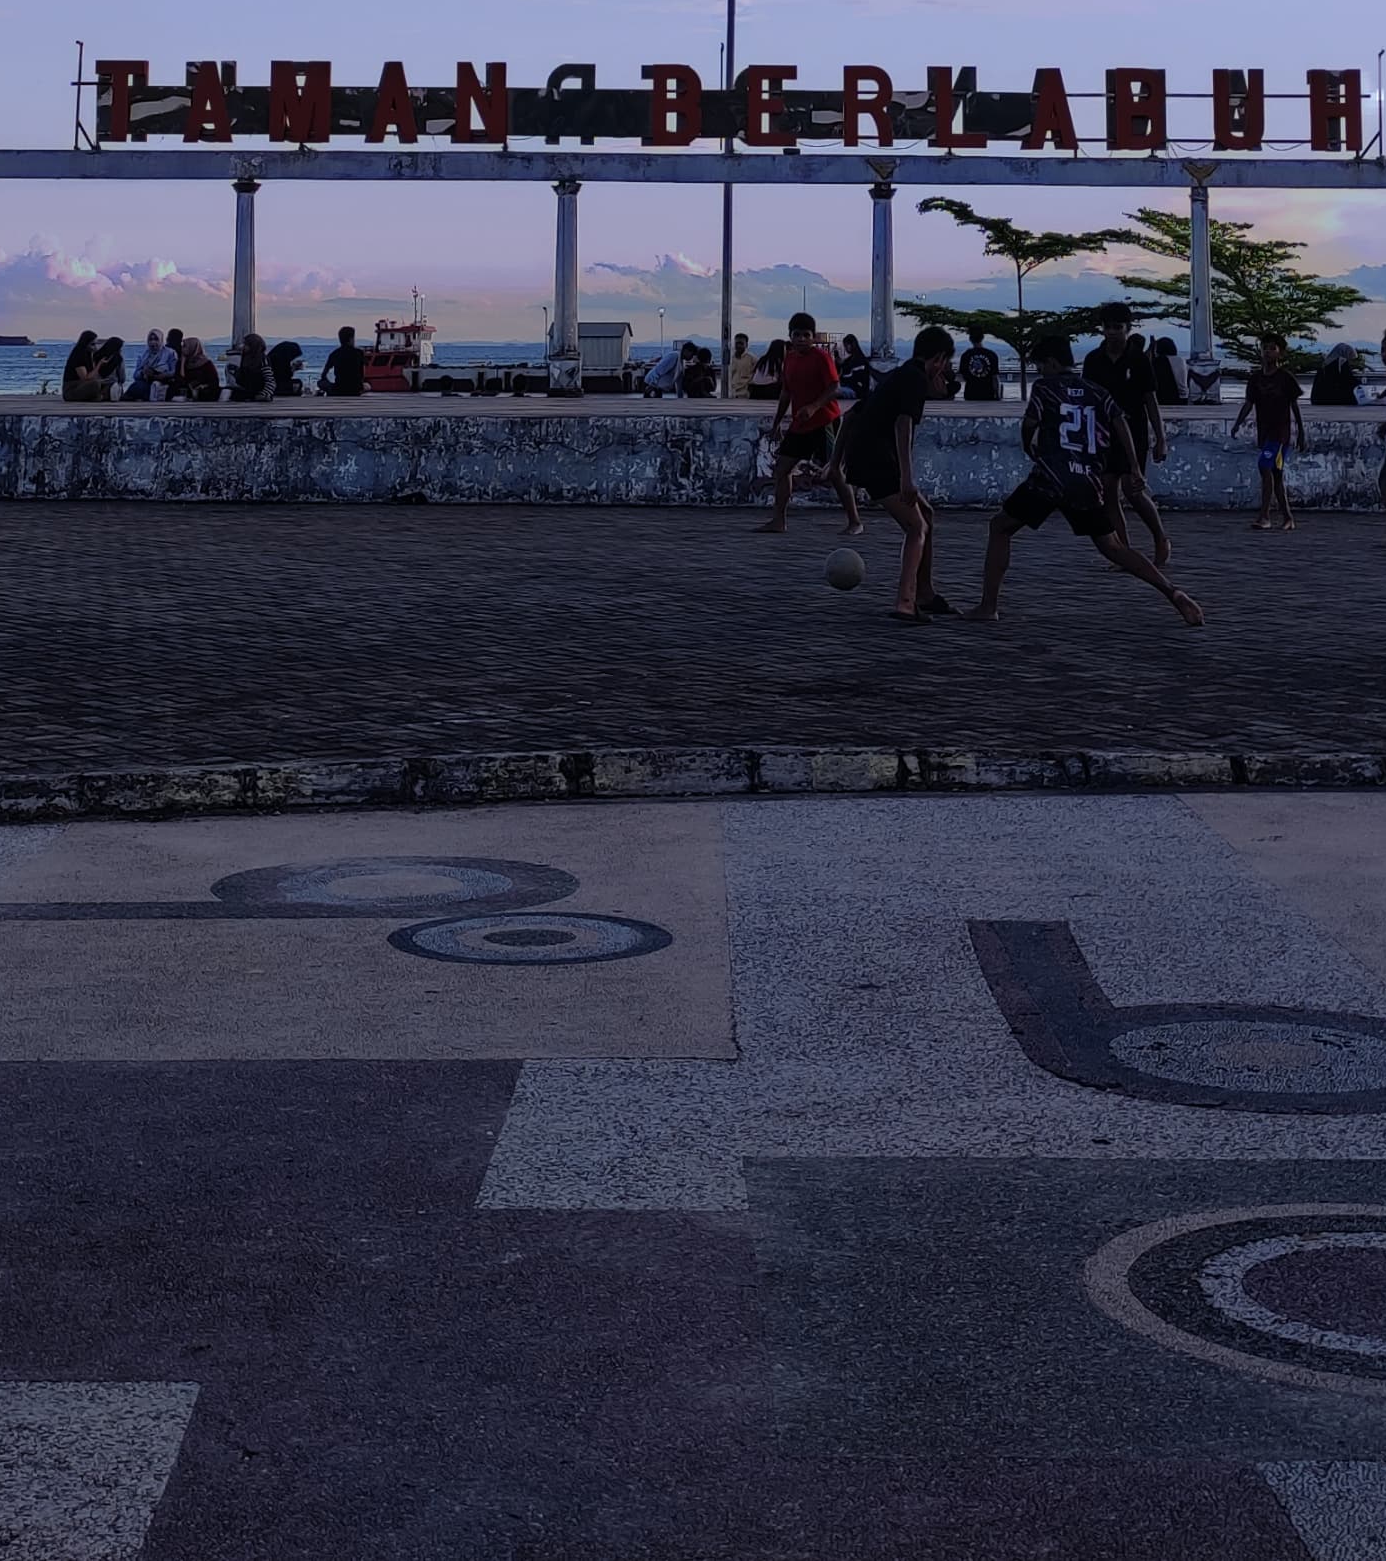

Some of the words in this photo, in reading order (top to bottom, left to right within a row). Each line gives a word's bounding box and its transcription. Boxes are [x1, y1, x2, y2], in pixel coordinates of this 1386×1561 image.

[96, 60, 507, 143] TAMAN
[652, 64, 1363, 152] BERLABUH
[1059, 403, 1096, 454] 21
